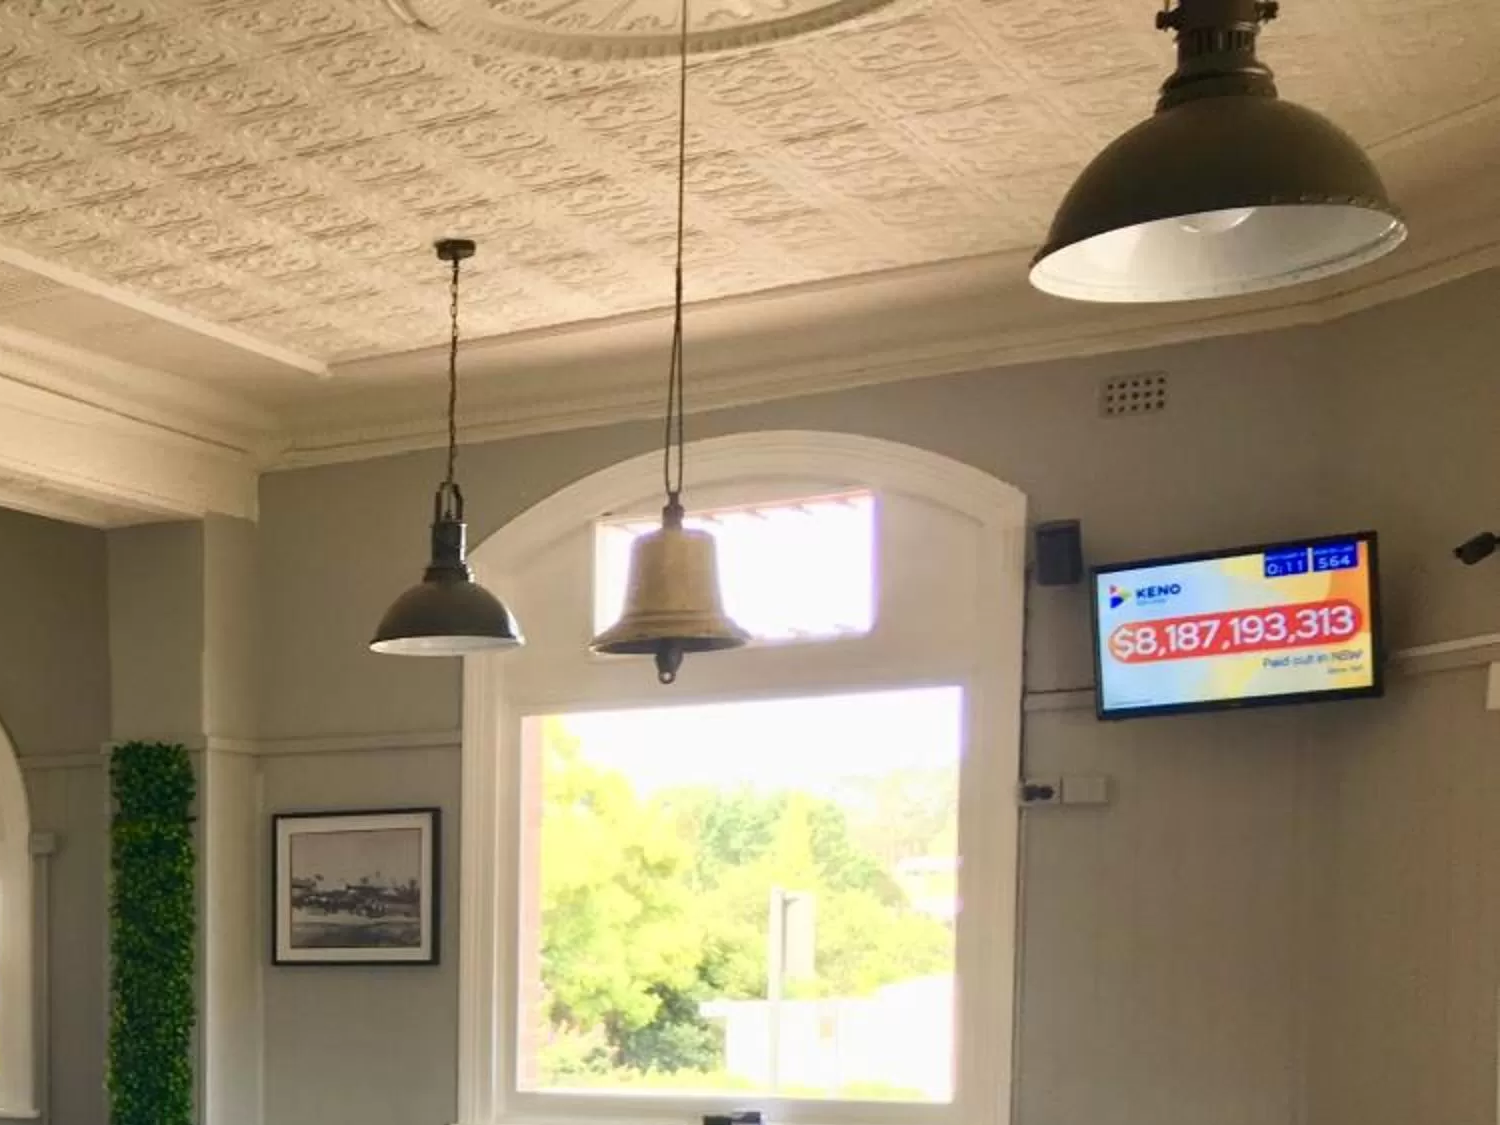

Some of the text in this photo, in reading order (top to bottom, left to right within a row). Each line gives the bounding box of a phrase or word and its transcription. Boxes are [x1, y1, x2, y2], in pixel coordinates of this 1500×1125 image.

[1318, 555, 1351, 569] 564
[1135, 583, 1182, 599] KENO
[1113, 605, 1355, 659] $8,187,193,313
